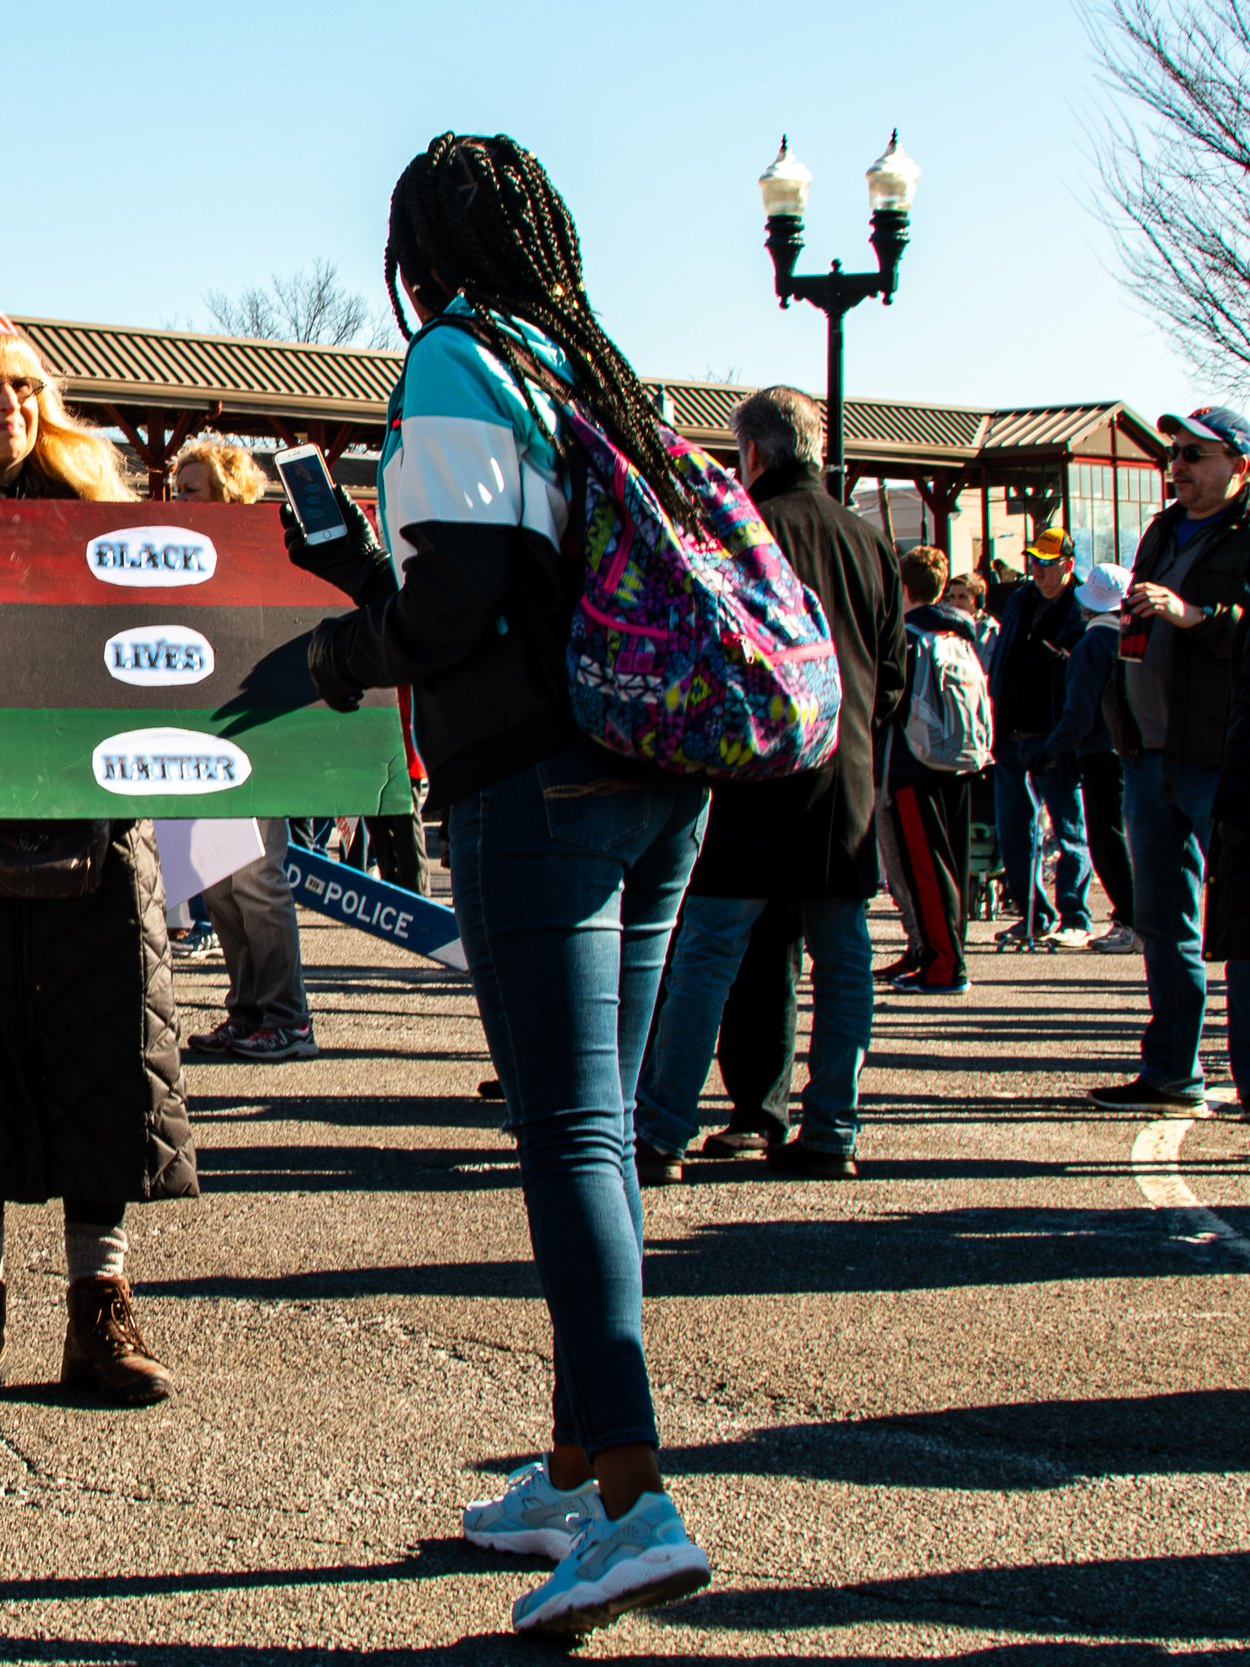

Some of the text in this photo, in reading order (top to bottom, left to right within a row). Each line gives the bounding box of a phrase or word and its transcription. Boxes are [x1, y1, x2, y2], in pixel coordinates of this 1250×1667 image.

[94, 541, 206, 572] BLACK
[112, 638, 204, 671] LIVES
[102, 754, 236, 781] MATTER
[323, 881, 414, 939] POLICE
